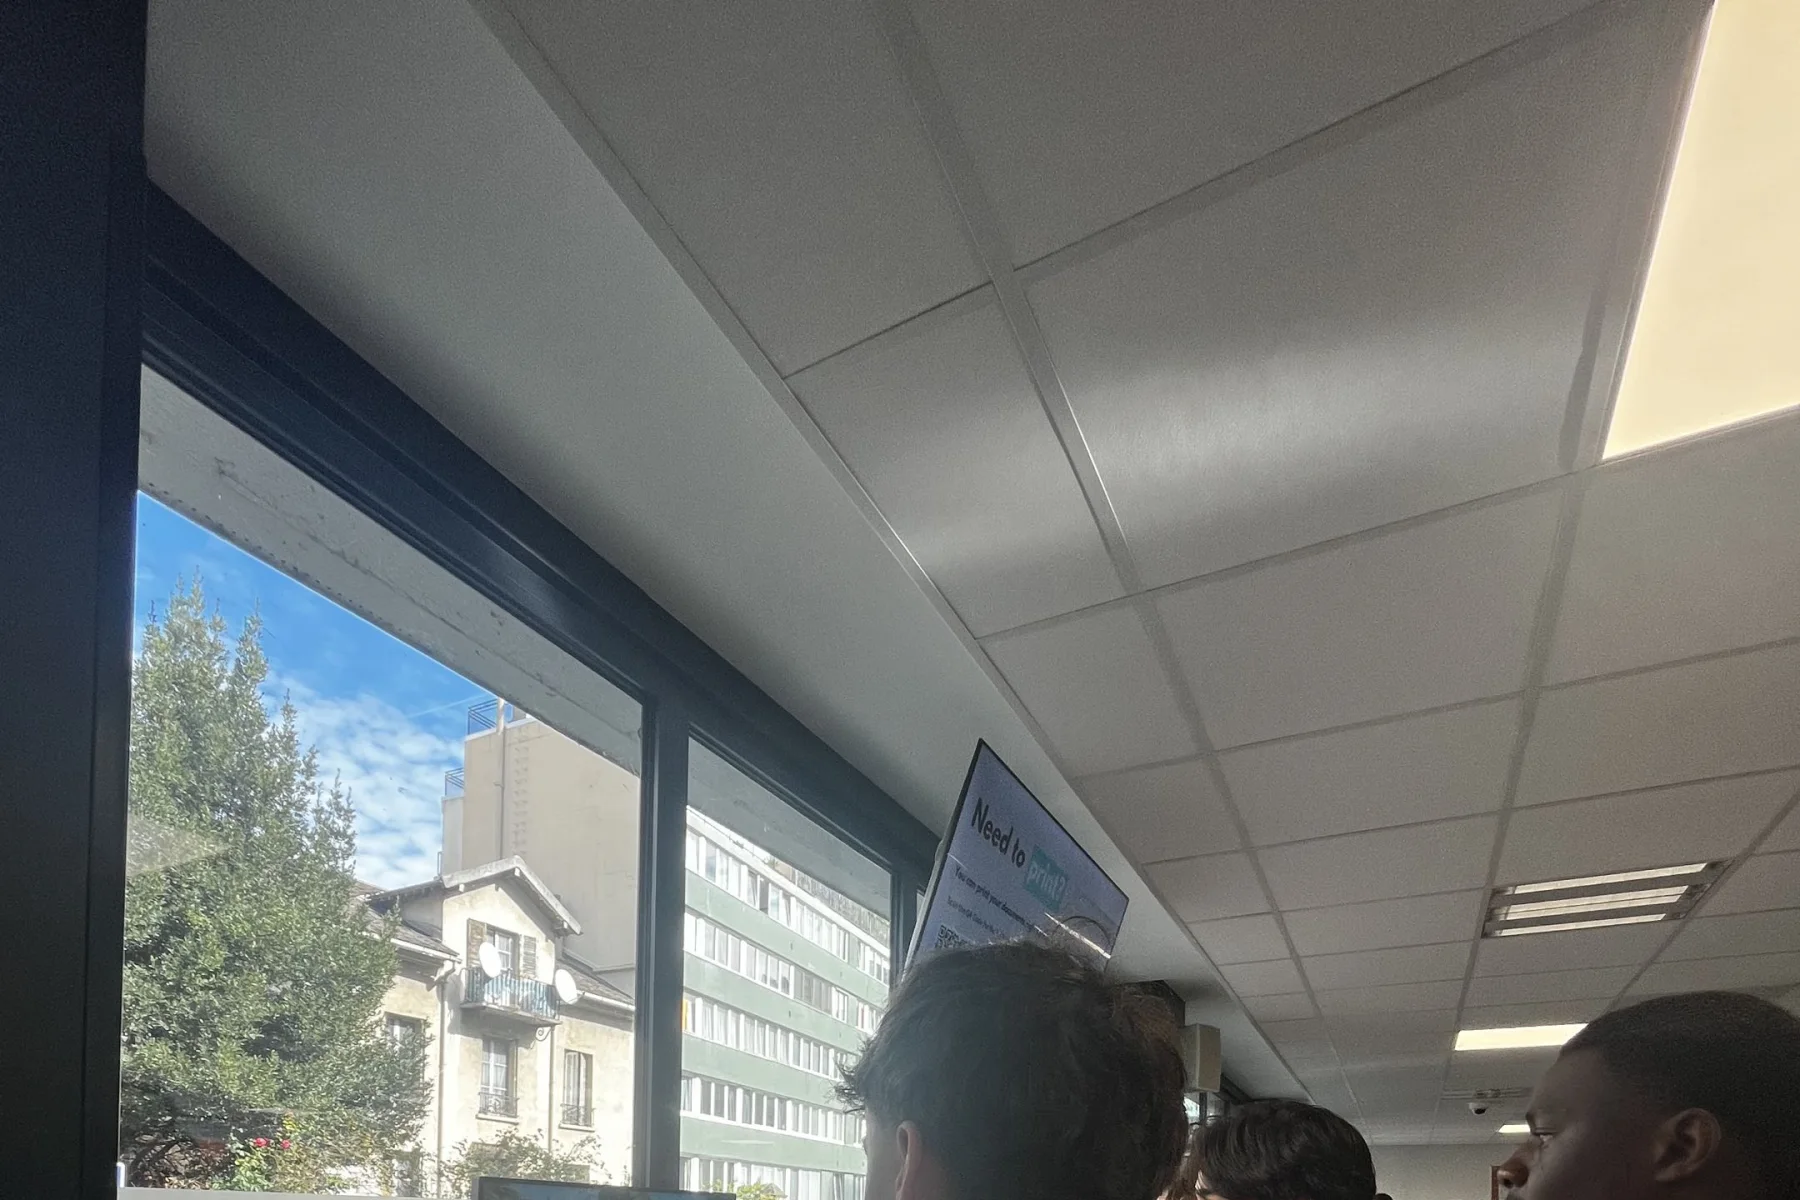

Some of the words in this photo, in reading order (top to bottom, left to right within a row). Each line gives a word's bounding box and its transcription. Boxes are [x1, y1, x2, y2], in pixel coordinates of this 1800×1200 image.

[971, 797, 1013, 855] Need
[1011, 838, 1025, 868] to
[1026, 860, 1066, 902] print?
